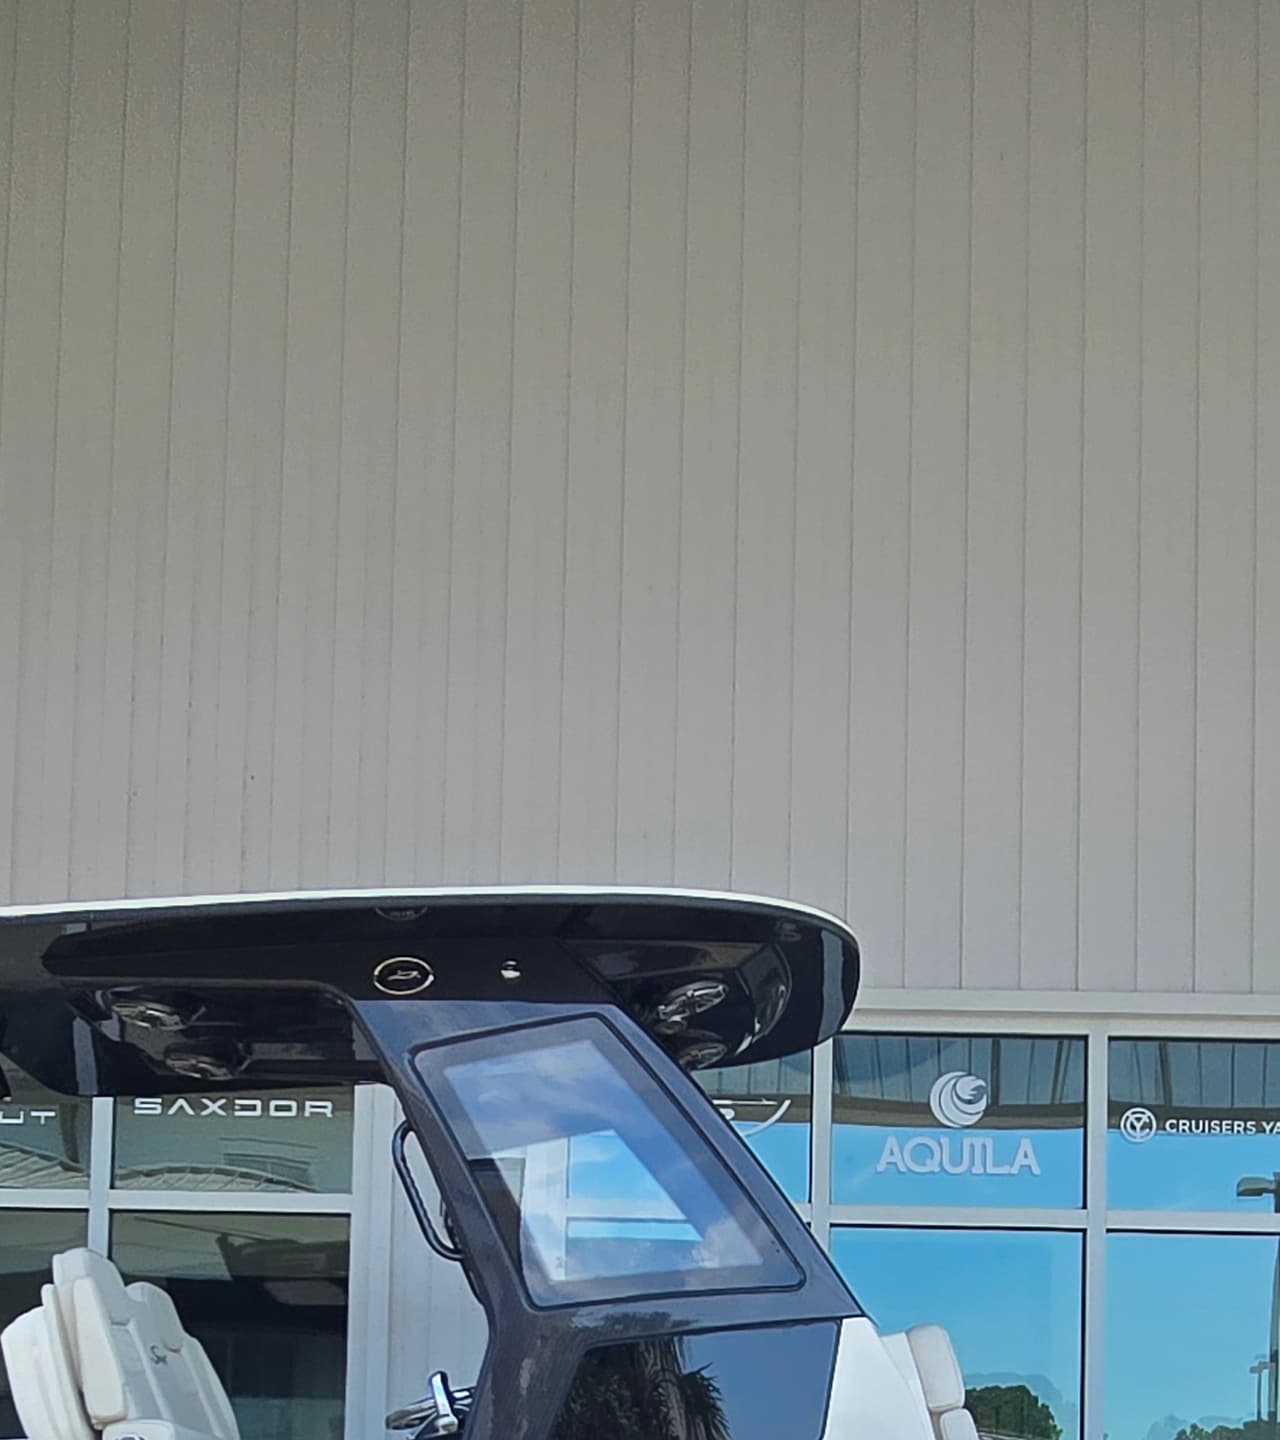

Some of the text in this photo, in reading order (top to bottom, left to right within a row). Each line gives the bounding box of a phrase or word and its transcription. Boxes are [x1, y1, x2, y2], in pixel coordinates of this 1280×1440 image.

[133, 1097, 335, 1119] SAXDOR
[1165, 1118, 1257, 1135] CRUISERS
[876, 1136, 1041, 1175] AQUILA
